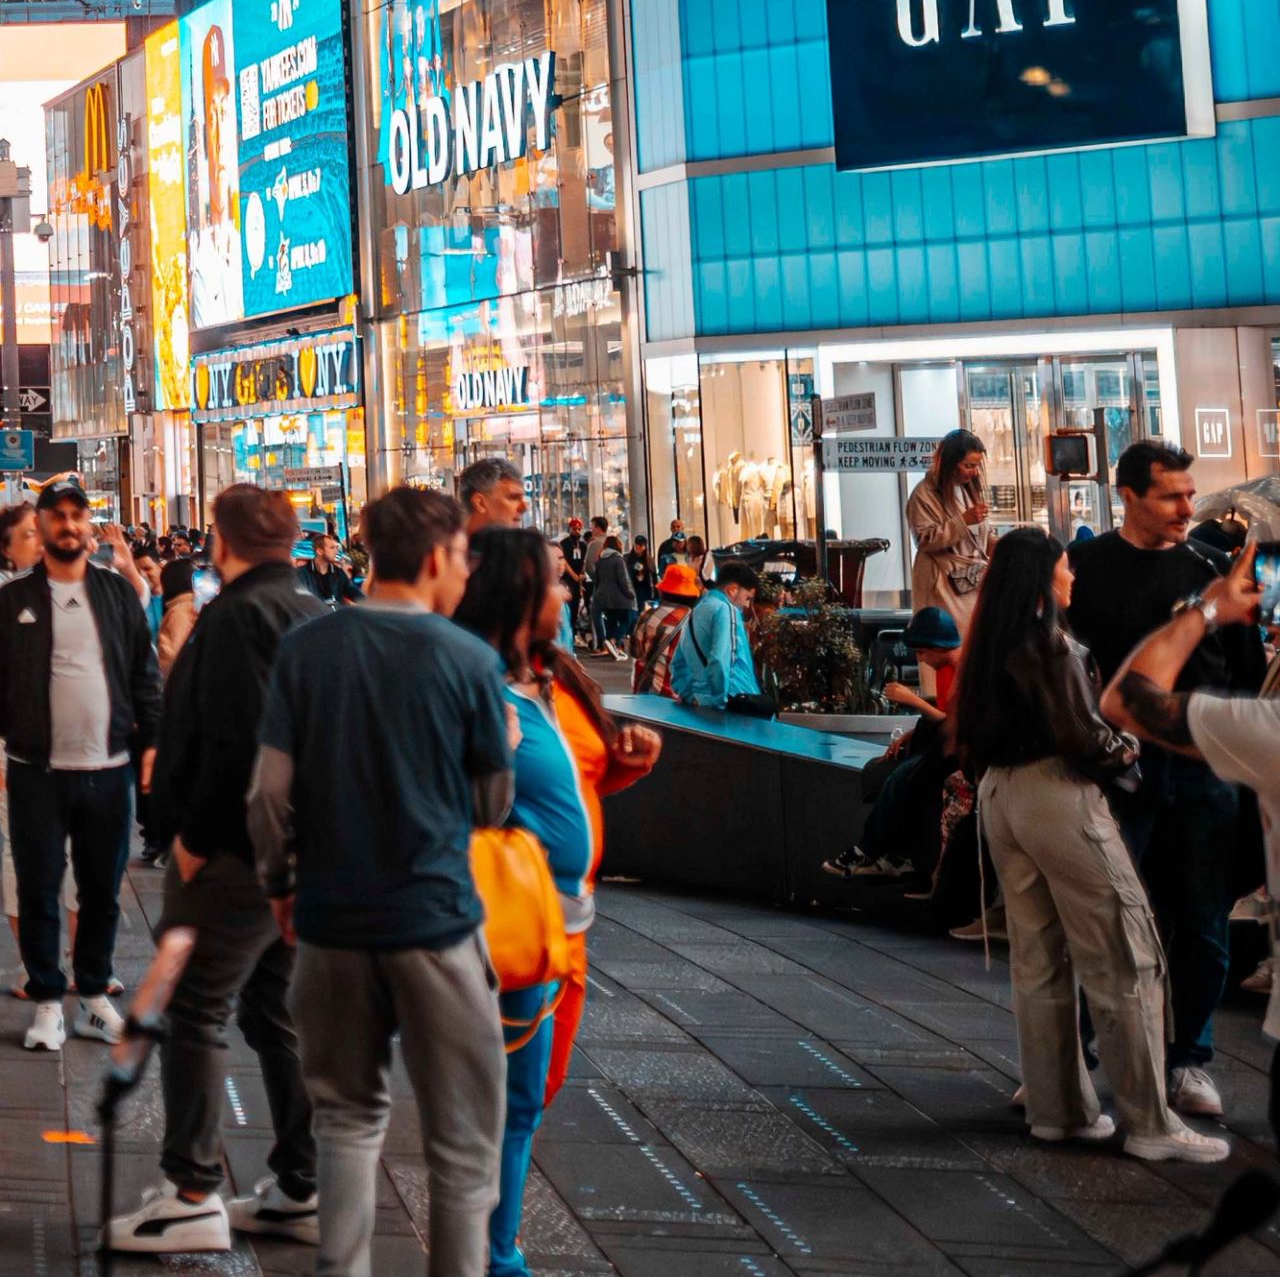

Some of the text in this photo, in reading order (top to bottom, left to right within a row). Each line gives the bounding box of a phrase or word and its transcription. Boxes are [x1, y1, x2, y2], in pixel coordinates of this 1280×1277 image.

[390, 51, 558, 195] OLD NAVY
[457, 366, 530, 410] OLD NAVY
[1203, 421, 1223, 444] GAP
[838, 441, 941, 453] PEDESTRIAN FLOW ZON
[838, 456, 896, 467] KEEP MOVING
